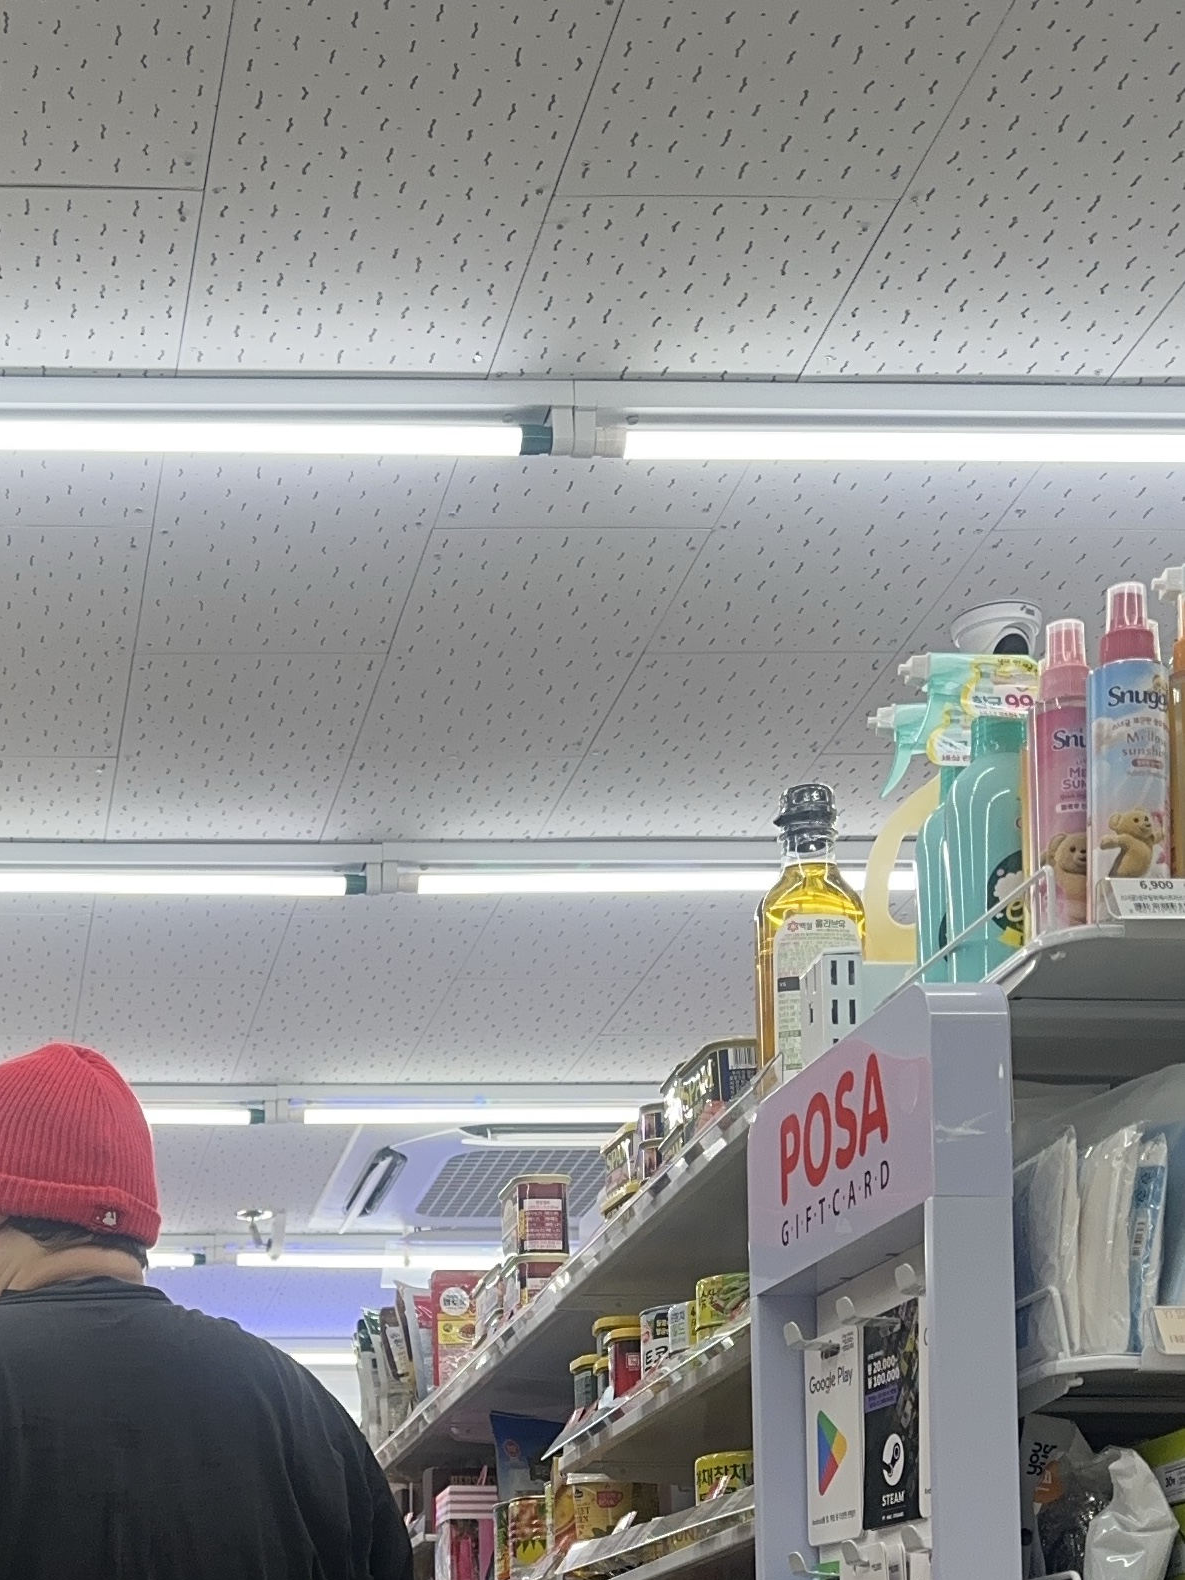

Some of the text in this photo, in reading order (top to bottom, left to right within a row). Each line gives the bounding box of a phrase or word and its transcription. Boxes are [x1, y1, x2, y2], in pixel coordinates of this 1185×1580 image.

[1107, 685, 1168, 713] Snugg
[1126, 730, 1163, 744] Mello
[1121, 748, 1163, 757] sunshi
[1139, 880, 1174, 891] 6,900
[780, 1053, 889, 1207] POSA
[809, 1366, 854, 1395] Google Play
[881, 1492, 905, 1507] STEAM
